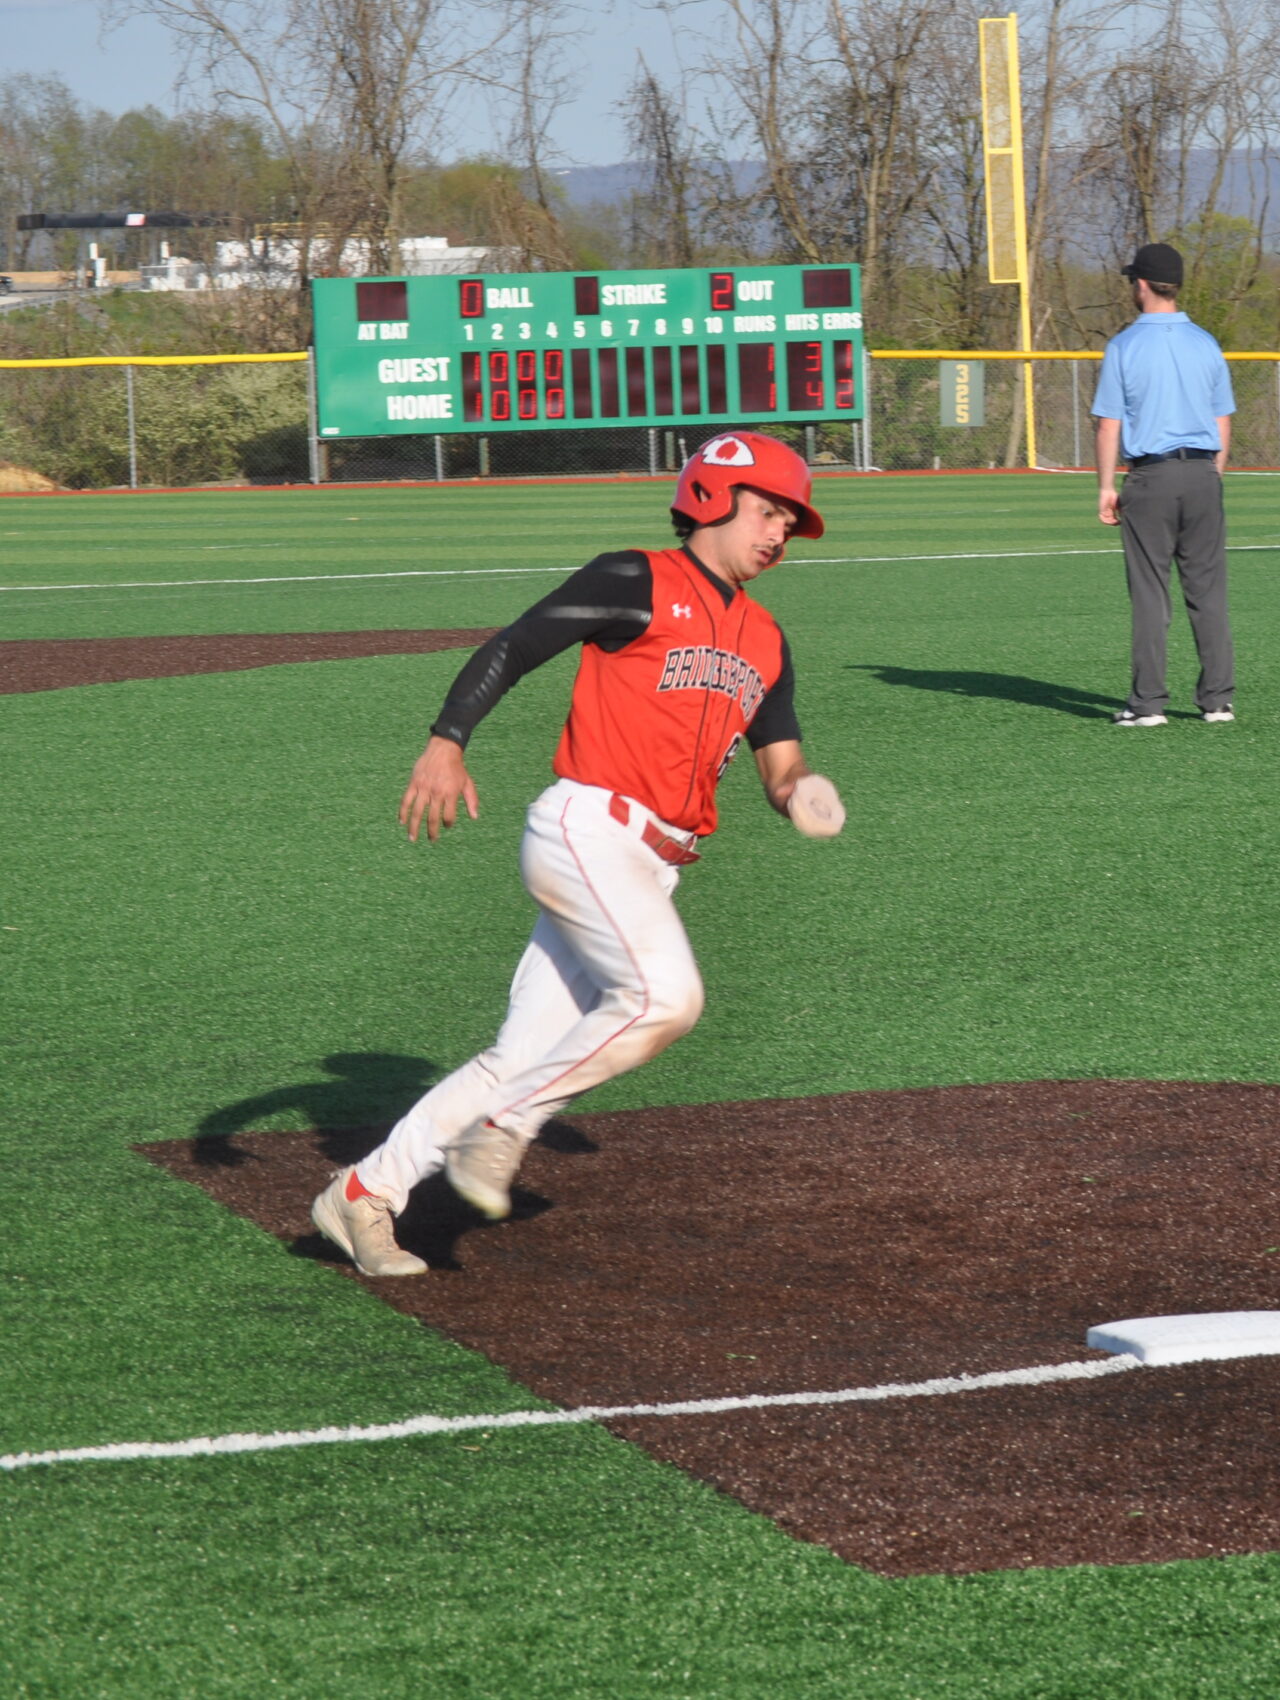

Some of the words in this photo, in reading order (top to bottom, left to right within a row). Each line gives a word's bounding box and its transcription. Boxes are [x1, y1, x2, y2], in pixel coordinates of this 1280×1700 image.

[460, 282, 483, 316] 0
[486, 287, 534, 308] BALL
[601, 284, 667, 306] STRIKE
[712, 275, 732, 309] 2
[737, 280, 774, 301] OUT
[358, 323, 376, 340] AT
[379, 323, 409, 340] BAT
[463, 324, 474, 341] 1
[491, 324, 503, 340] 2
[519, 323, 531, 339] 3
[546, 322, 559, 338] 4
[574, 321, 586, 337] 5
[601, 320, 613, 337] 6
[628, 320, 639, 336] 7
[655, 319, 667, 335] 8
[682, 318, 694, 334] 9
[704, 317, 723, 333] 10
[734, 316, 776, 332] RUNS
[785, 314, 819, 331] HITS
[823, 312, 862, 329] ERRS
[378, 357, 451, 383] GUEST
[489, 352, 508, 382] 0
[517, 352, 536, 381] 0
[544, 351, 562, 380] 0
[806, 343, 821, 371] 3
[387, 394, 454, 420] HOME
[491, 391, 510, 420] 0
[518, 390, 537, 419] 0
[546, 389, 564, 418] 0
[807, 381, 823, 407] 4
[836, 379, 853, 408] 2
[955, 363, 970, 424] 325
